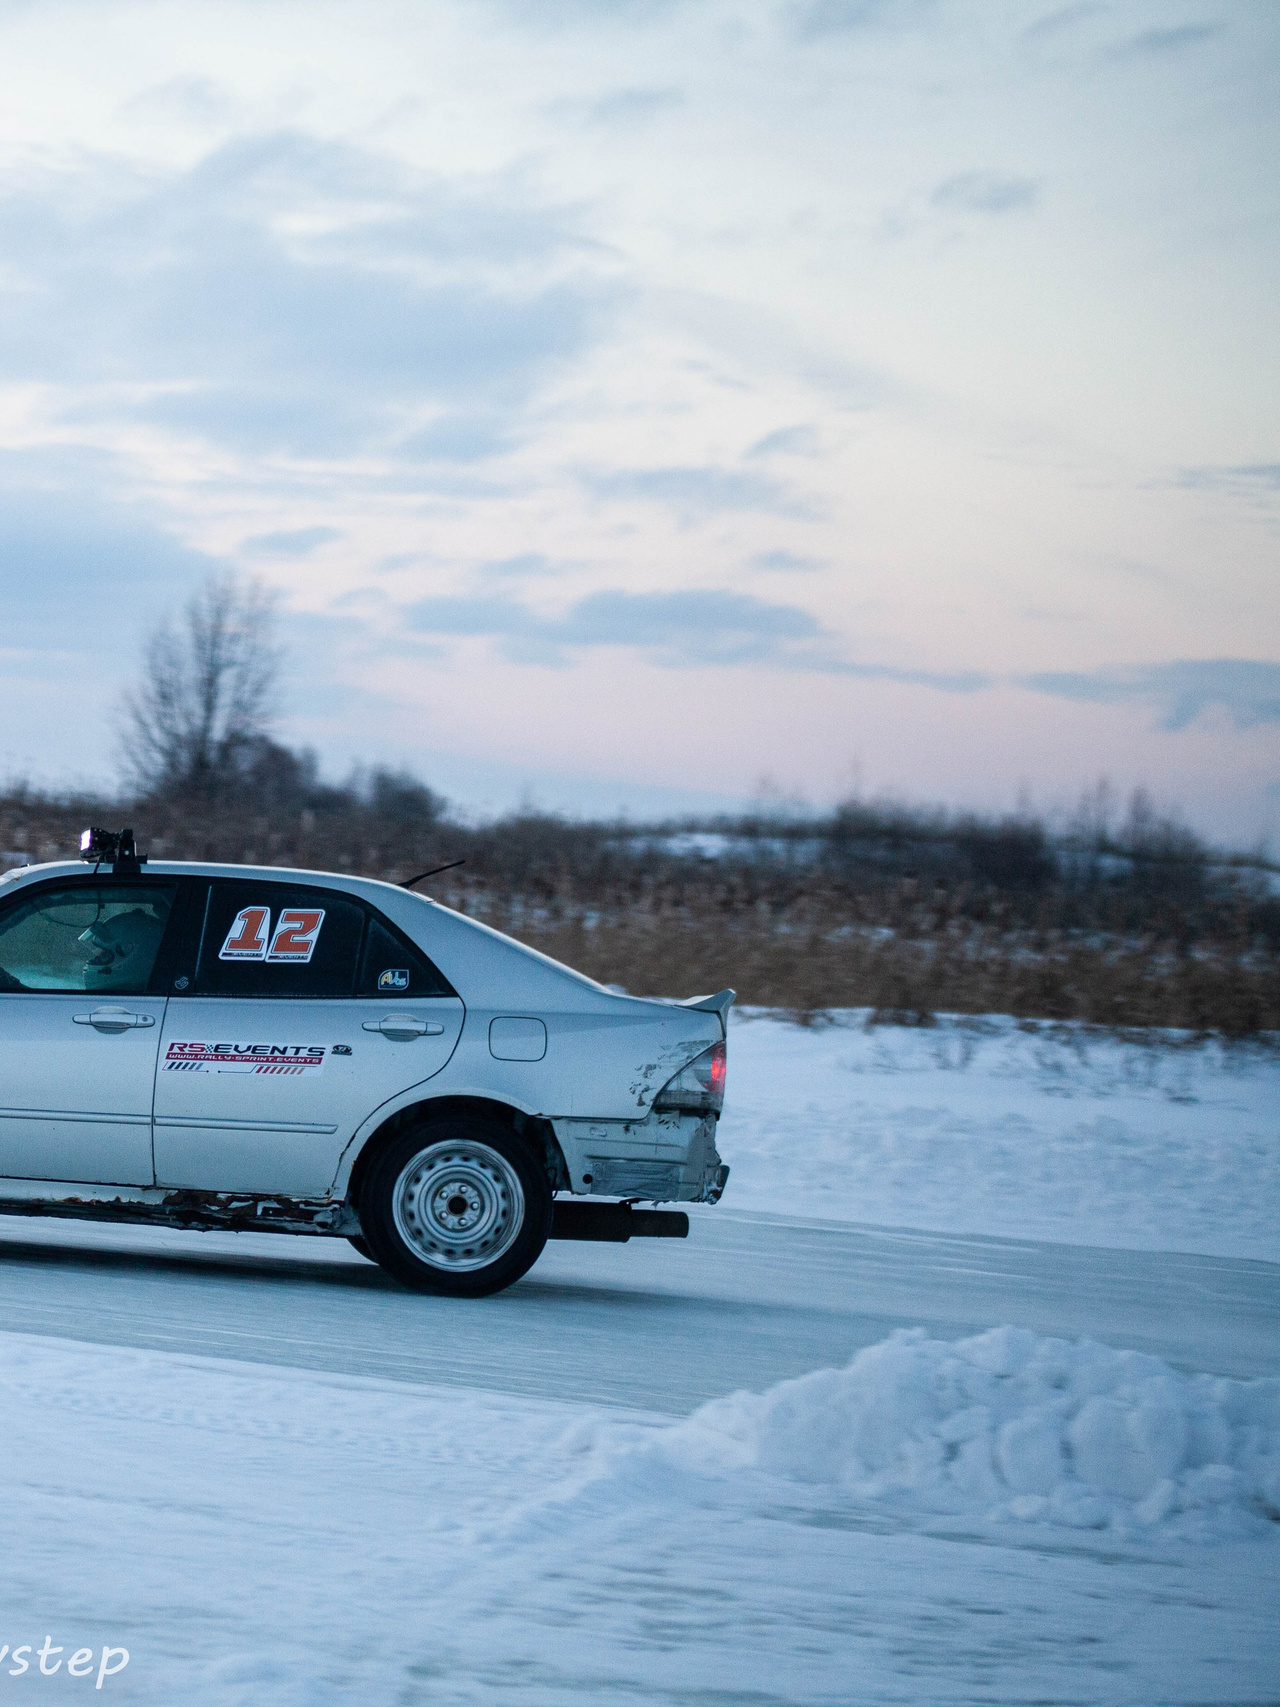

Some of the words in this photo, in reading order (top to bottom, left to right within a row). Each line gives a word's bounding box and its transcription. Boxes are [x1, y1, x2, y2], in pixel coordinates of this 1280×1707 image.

[225, 908, 322, 954] 12
[168, 1042, 206, 1053] RS
[213, 1043, 326, 1057] EVENTS
